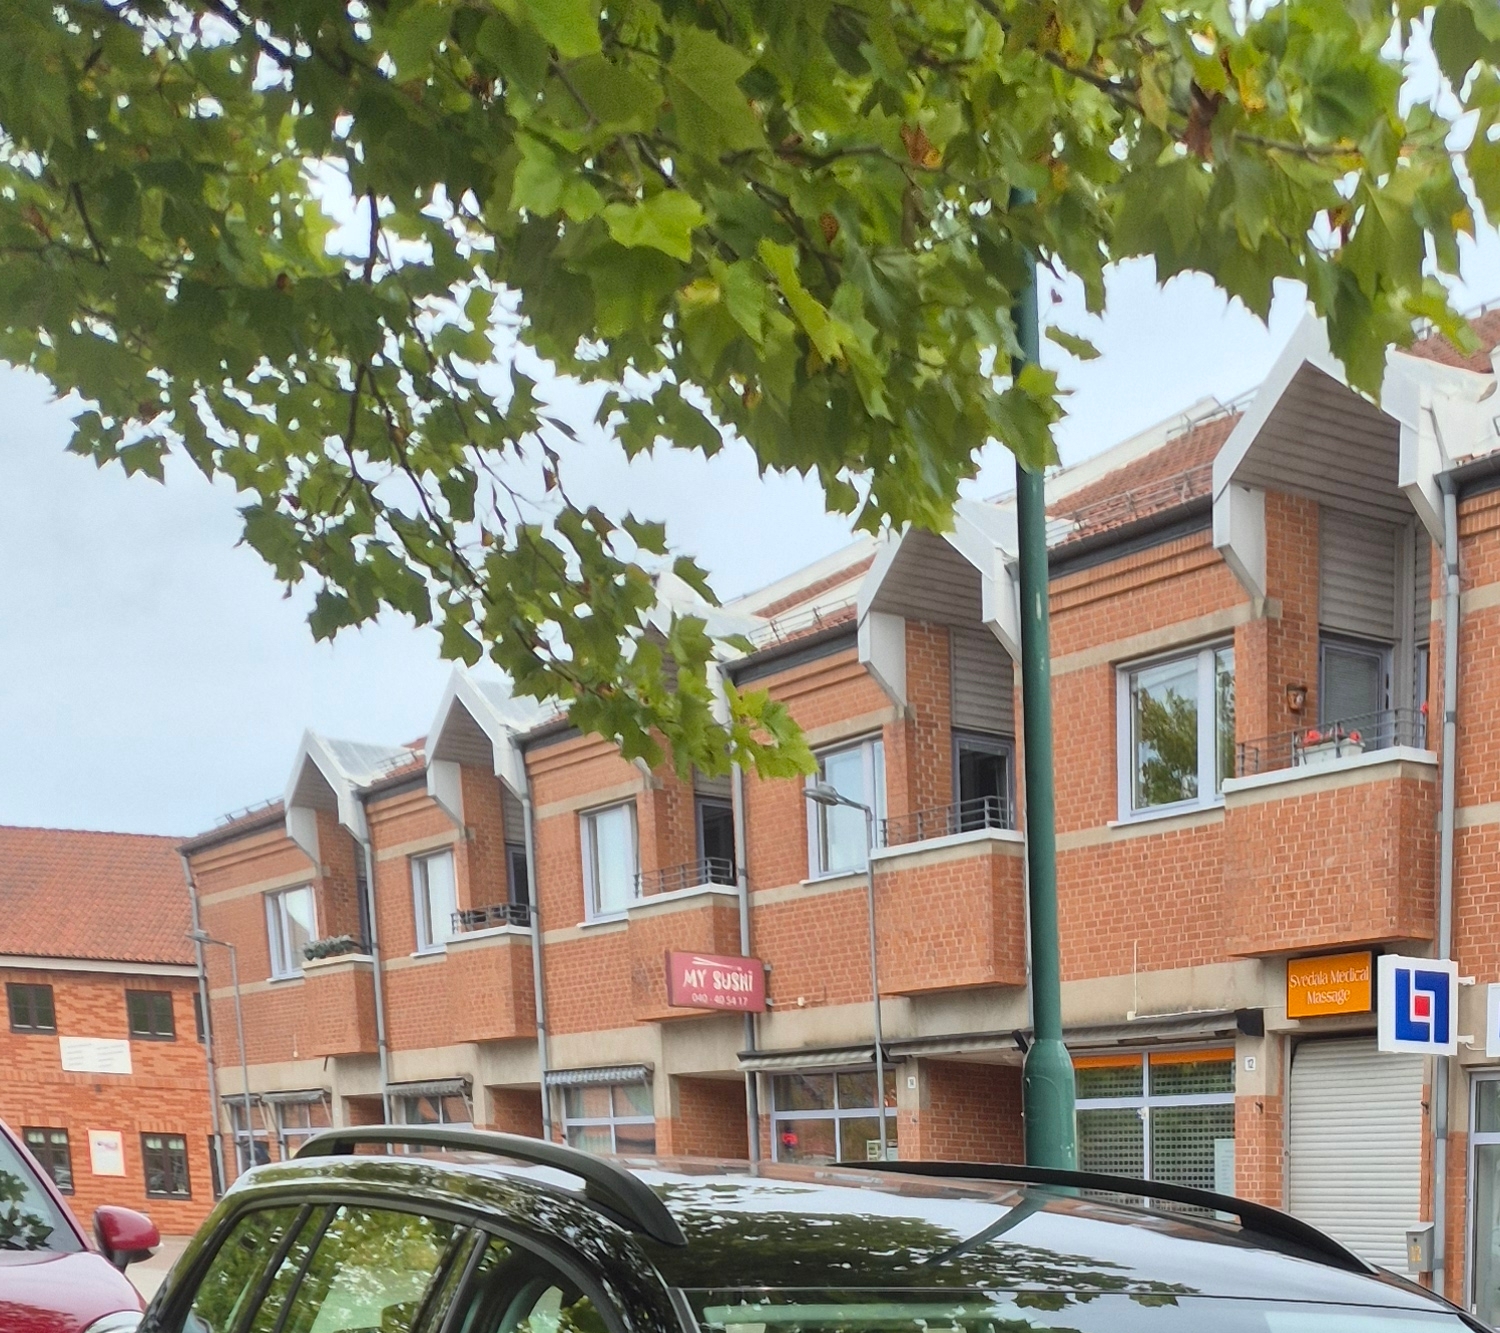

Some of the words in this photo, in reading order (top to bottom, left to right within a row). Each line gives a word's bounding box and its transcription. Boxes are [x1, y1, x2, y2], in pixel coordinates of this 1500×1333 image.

[683, 969, 707, 988] MY
[1289, 971, 1328, 988] Svedala
[1330, 966, 1369, 985] Medical
[1307, 989, 1351, 1006] Massage
